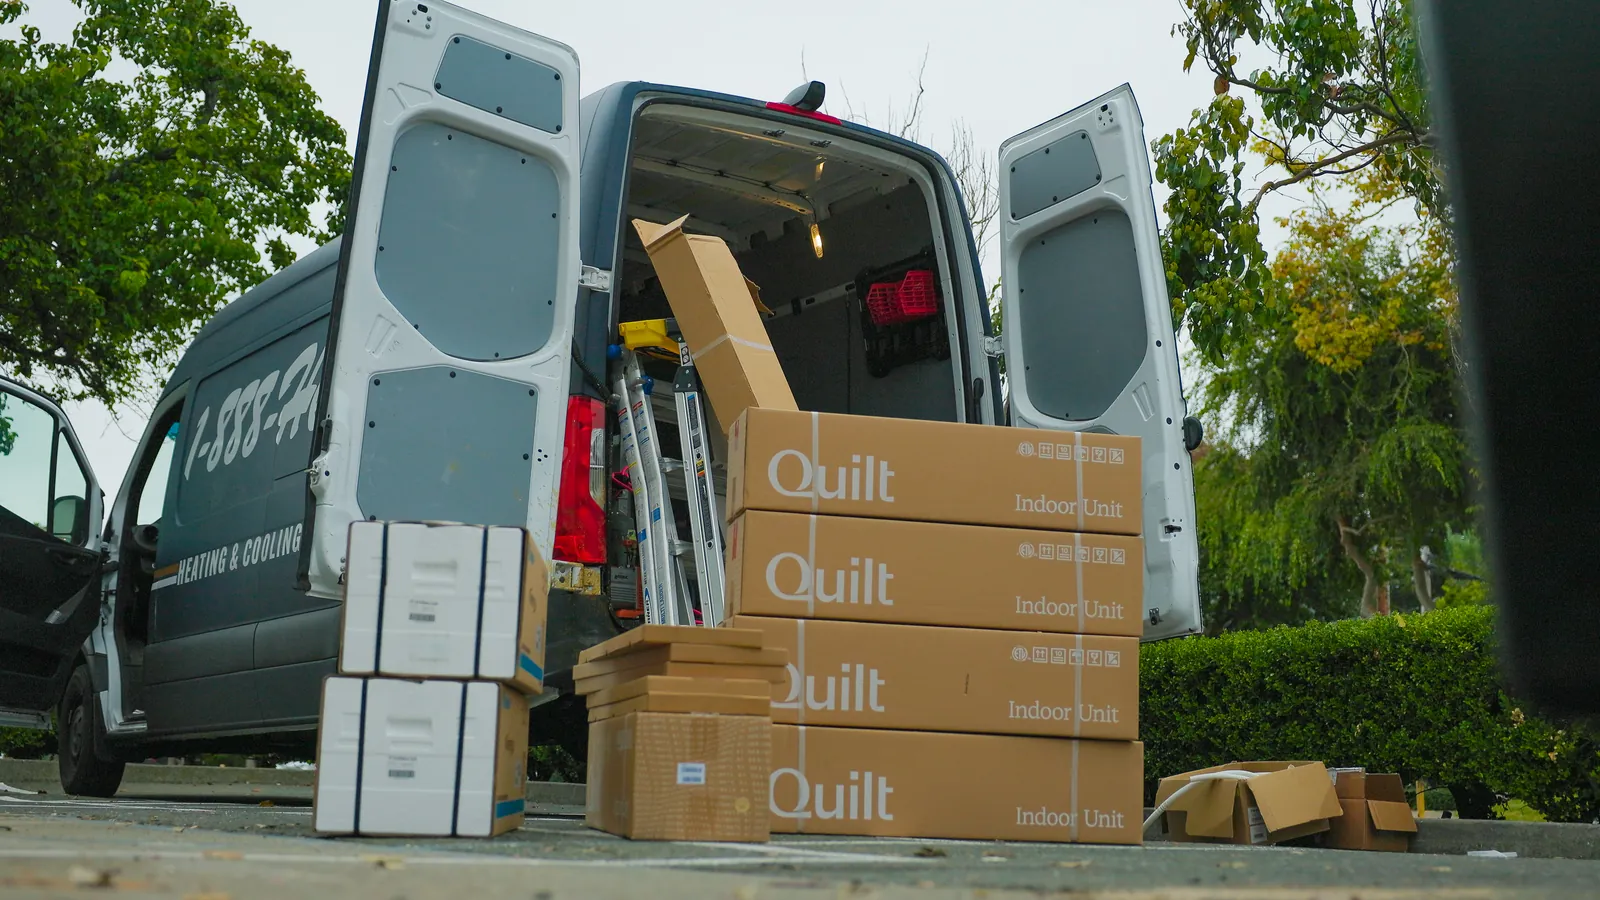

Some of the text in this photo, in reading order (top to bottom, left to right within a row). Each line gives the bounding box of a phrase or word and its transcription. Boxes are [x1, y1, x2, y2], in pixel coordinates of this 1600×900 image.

[767, 448, 895, 502] Quilt
[1015, 494, 1123, 518] Indoor Unit
[177, 522, 303, 586] HEATING & COOLING
[765, 552, 894, 606] Quilt
[1015, 595, 1124, 620] Indoor Unit
[1008, 700, 1119, 724] Indoor Unit
[769, 767, 894, 821] Quilt
[1016, 807, 1124, 829] Indoor Unit
